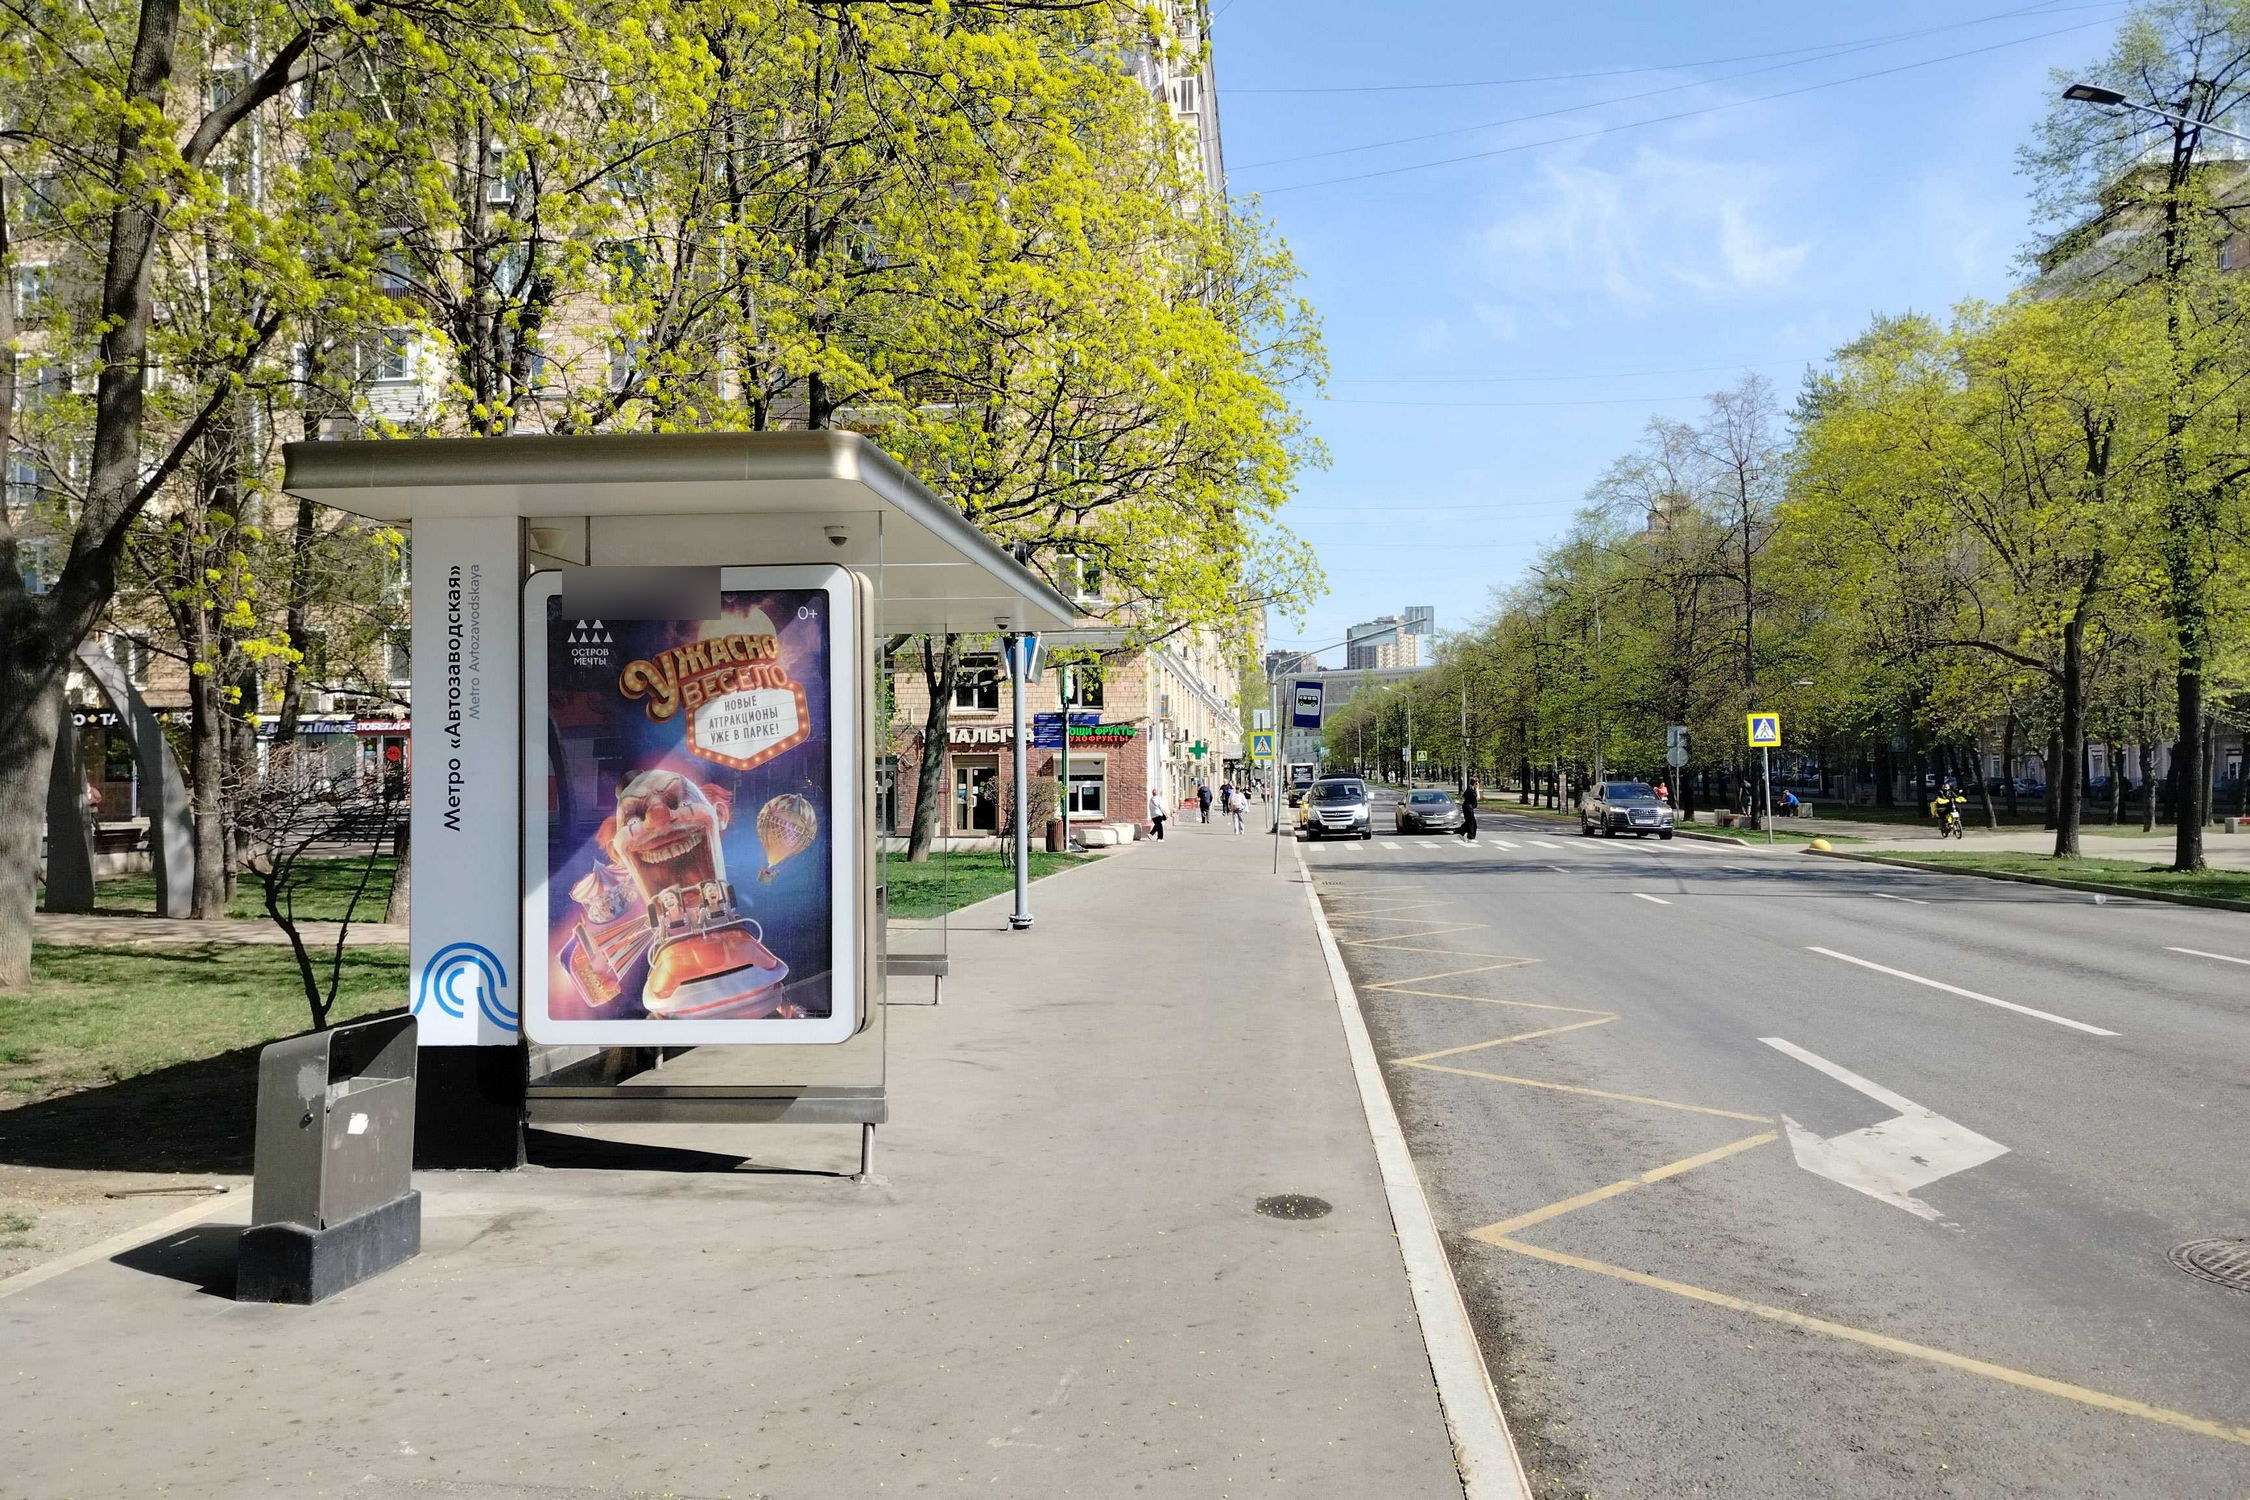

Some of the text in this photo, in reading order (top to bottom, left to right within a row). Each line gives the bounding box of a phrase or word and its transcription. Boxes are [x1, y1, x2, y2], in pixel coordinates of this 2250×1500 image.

[797, 606, 818, 620] 0+
[468, 564, 482, 720] Metro Avtozavodskaya
[571, 648, 609, 657] ОСТРОВ
[573, 657, 607, 666] МЕЧТЫ
[618, 633, 780, 724] УЖАСНО
[682, 663, 788, 711] ВЕСЕЛО
[444, 565, 465, 832] Метро «Автозаводская»
[724, 695, 758, 712] НОВЫЕ
[708, 706, 779, 730] АТТРАКЦИОНЫ
[710, 722, 780, 745] УЖЕ В ПАРКЕ!
[1095, 727, 1135, 736] ФРУКТЫ
